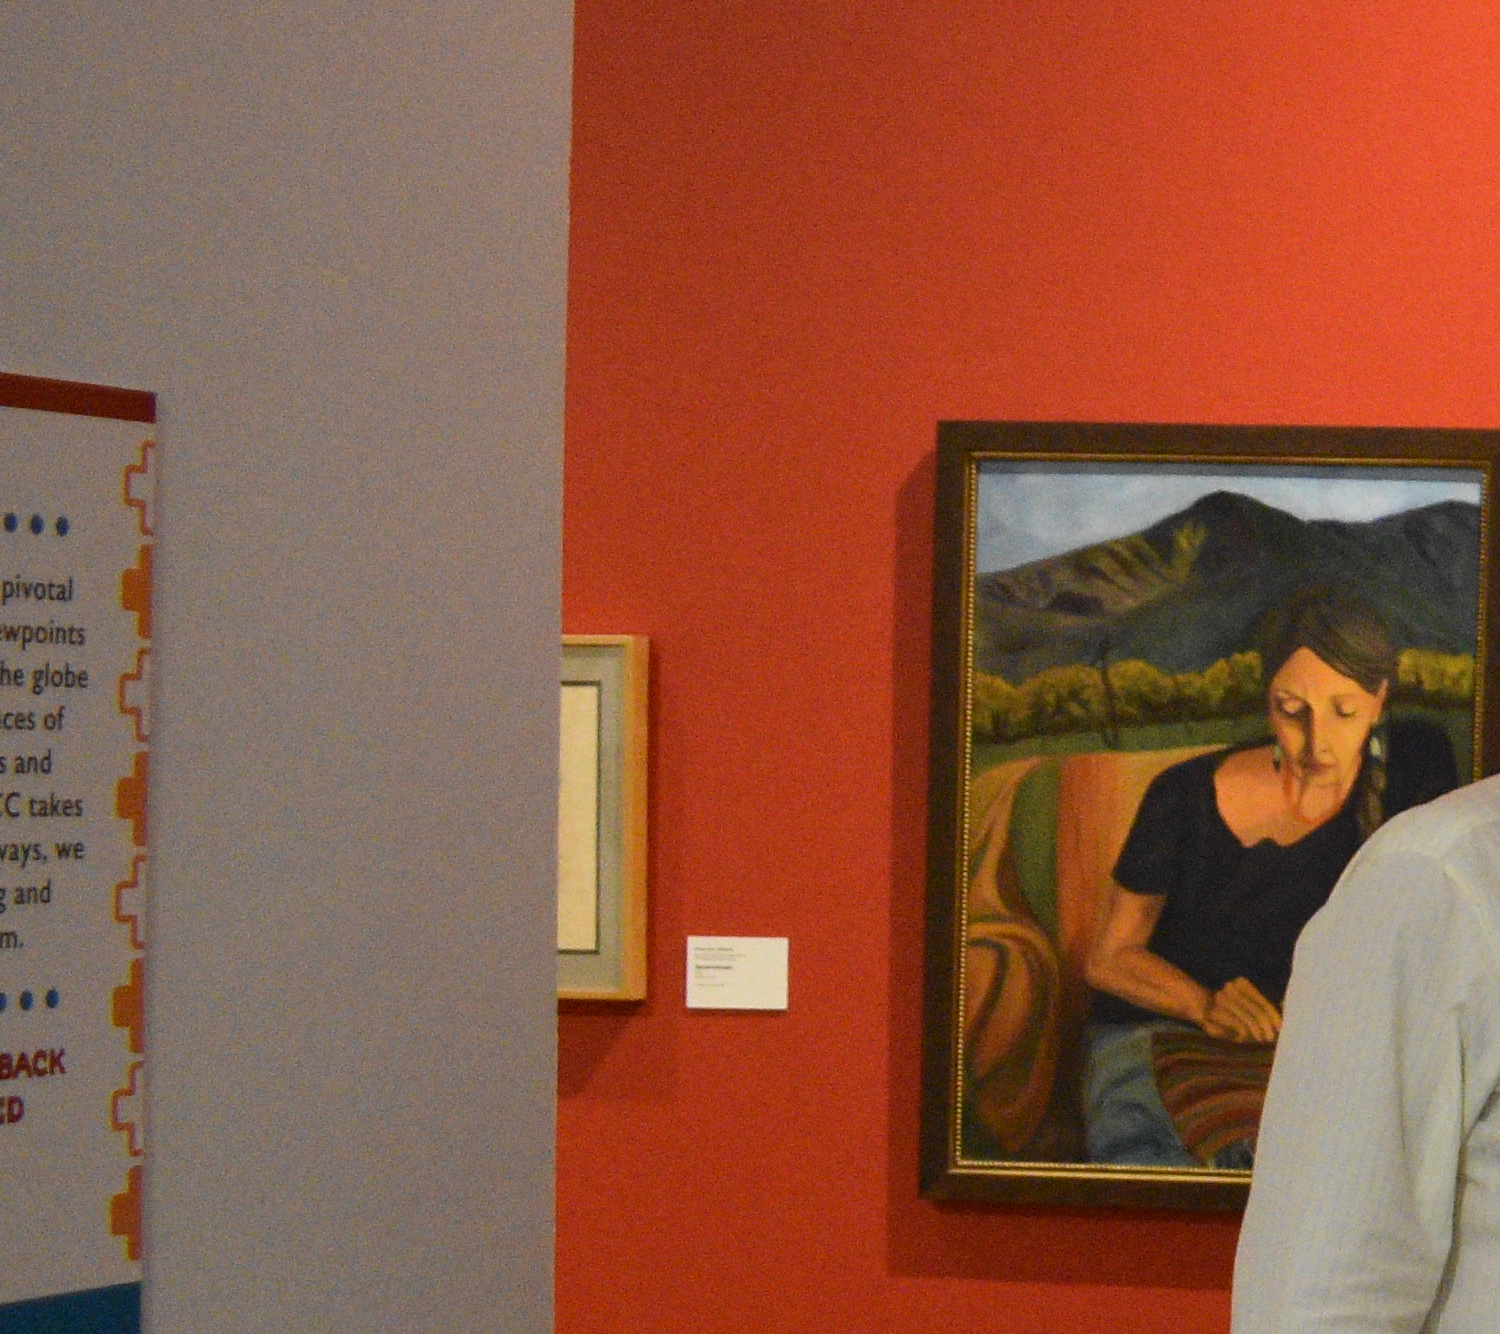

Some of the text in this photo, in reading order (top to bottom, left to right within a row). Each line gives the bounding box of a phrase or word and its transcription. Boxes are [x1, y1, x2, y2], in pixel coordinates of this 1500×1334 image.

[2, 574, 74, 605] pivotal
[32, 663, 89, 695] globe
[43, 705, 66, 730] of
[14, 749, 52, 775] and
[28, 793, 83, 817] takes
[56, 842, 85, 860] we
[14, 880, 52, 906] and
